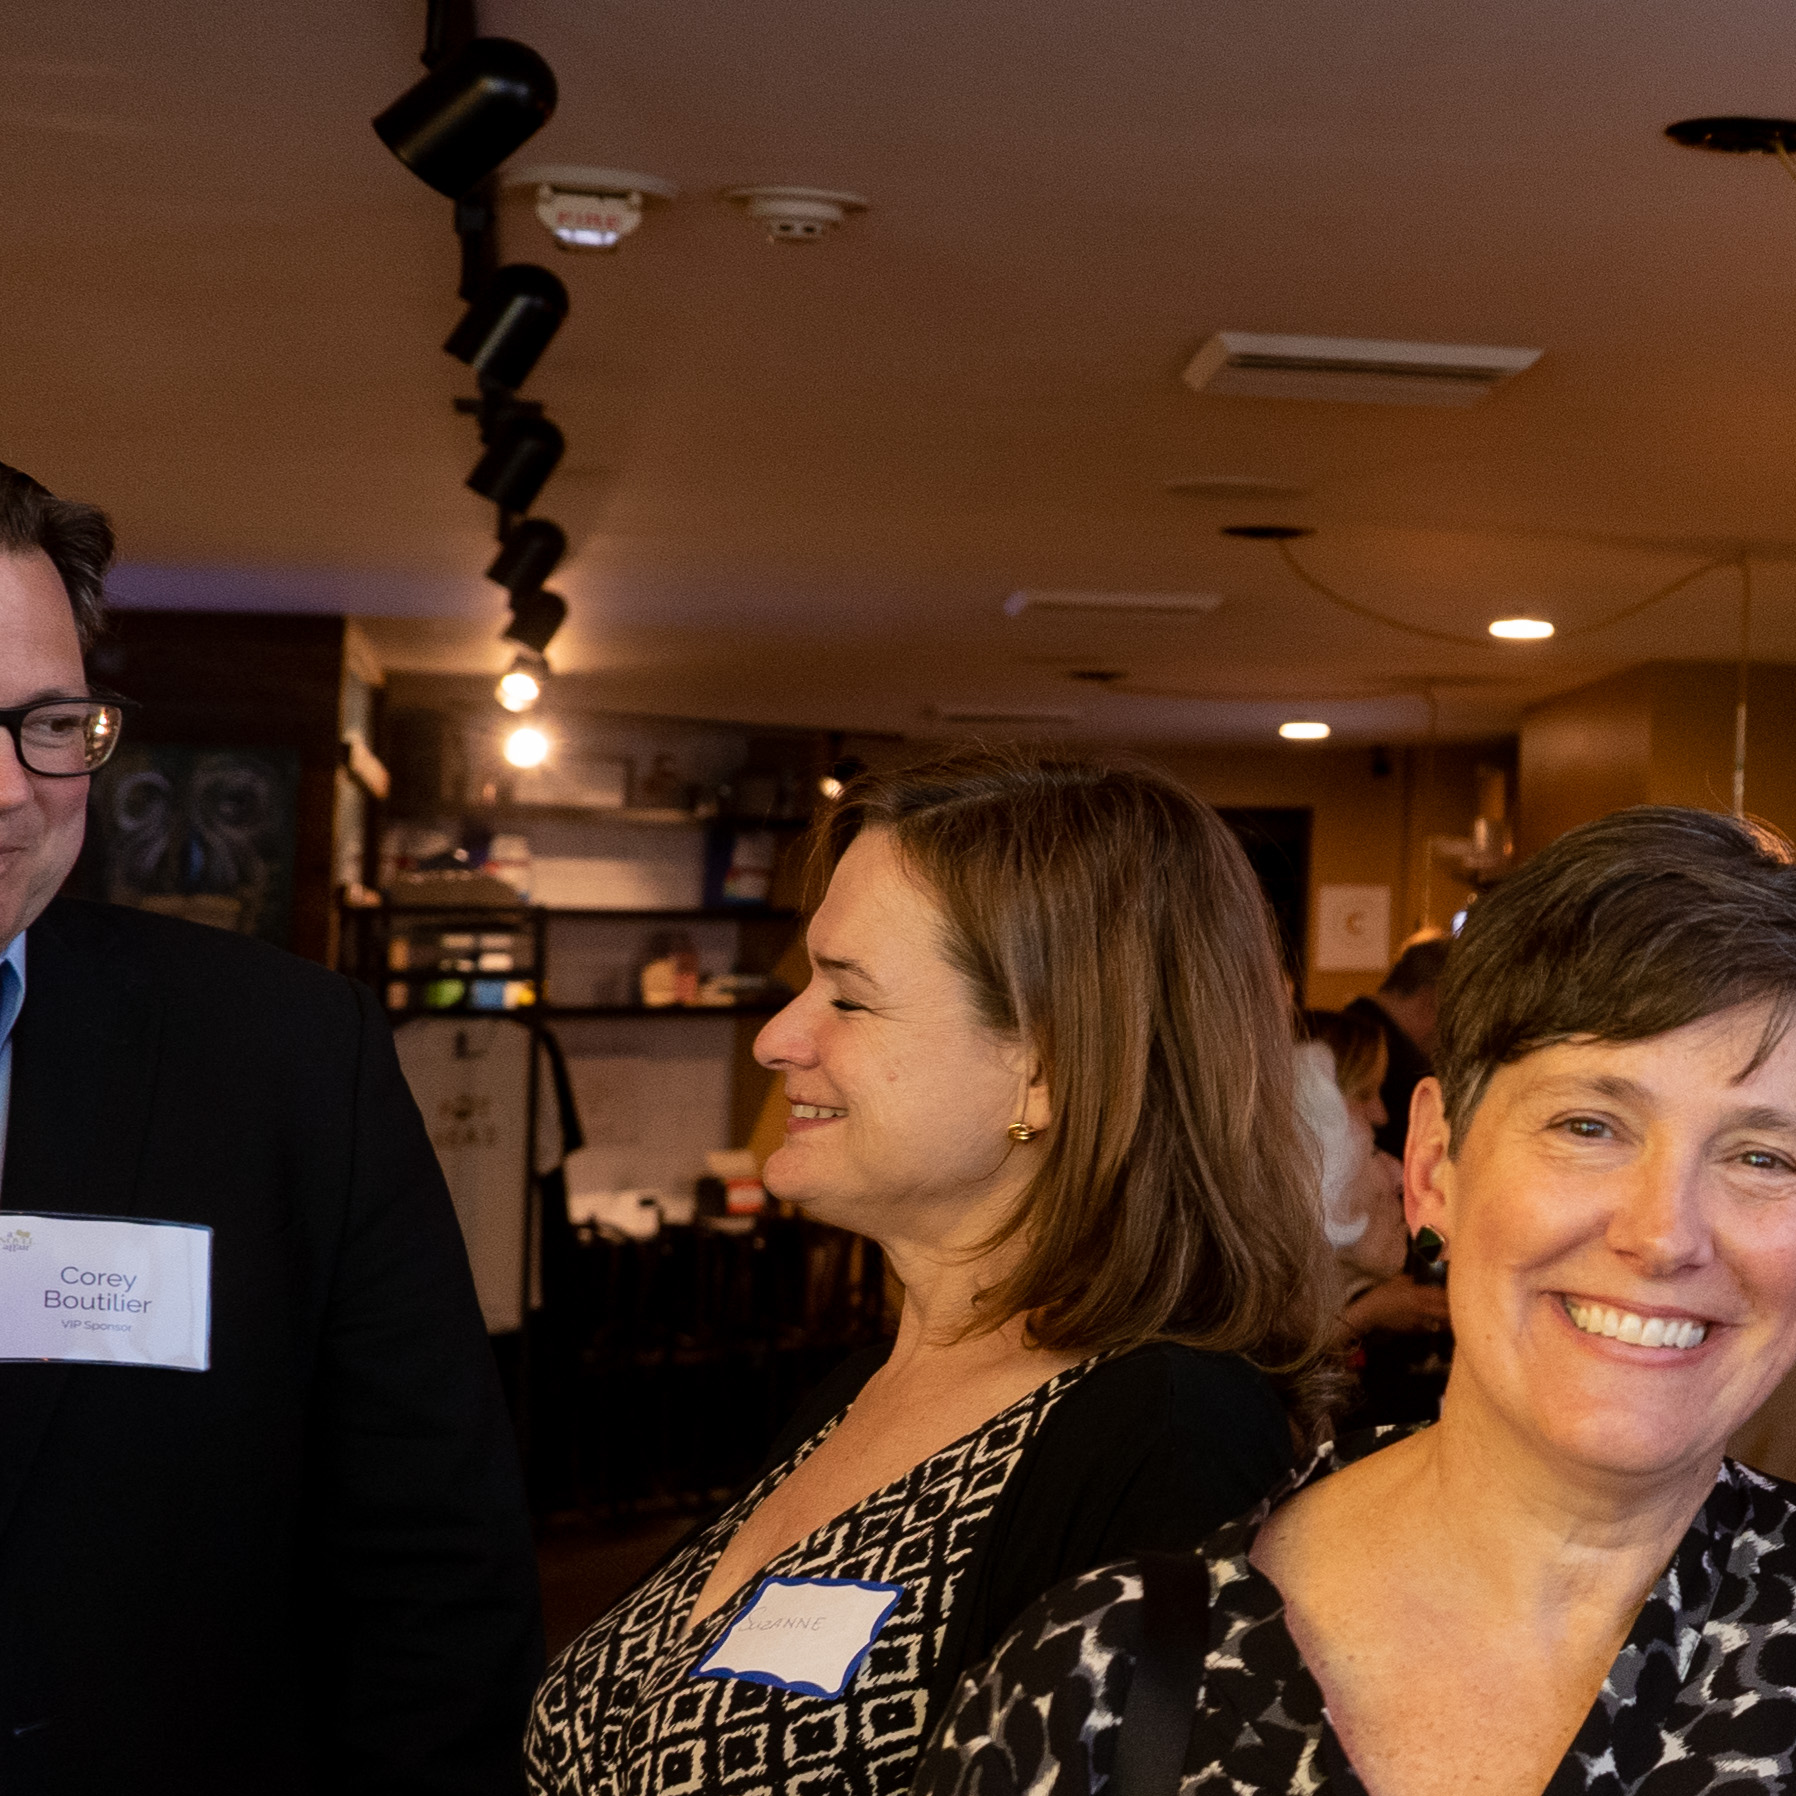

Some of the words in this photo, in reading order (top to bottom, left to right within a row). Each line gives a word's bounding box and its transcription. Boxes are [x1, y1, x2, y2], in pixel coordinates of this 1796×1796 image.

[60, 1266, 137, 1293] Corey
[44, 1289, 153, 1314] Boutilier
[61, 1319, 82, 1330] VIP
[84, 1320, 132, 1332] Sponsor
